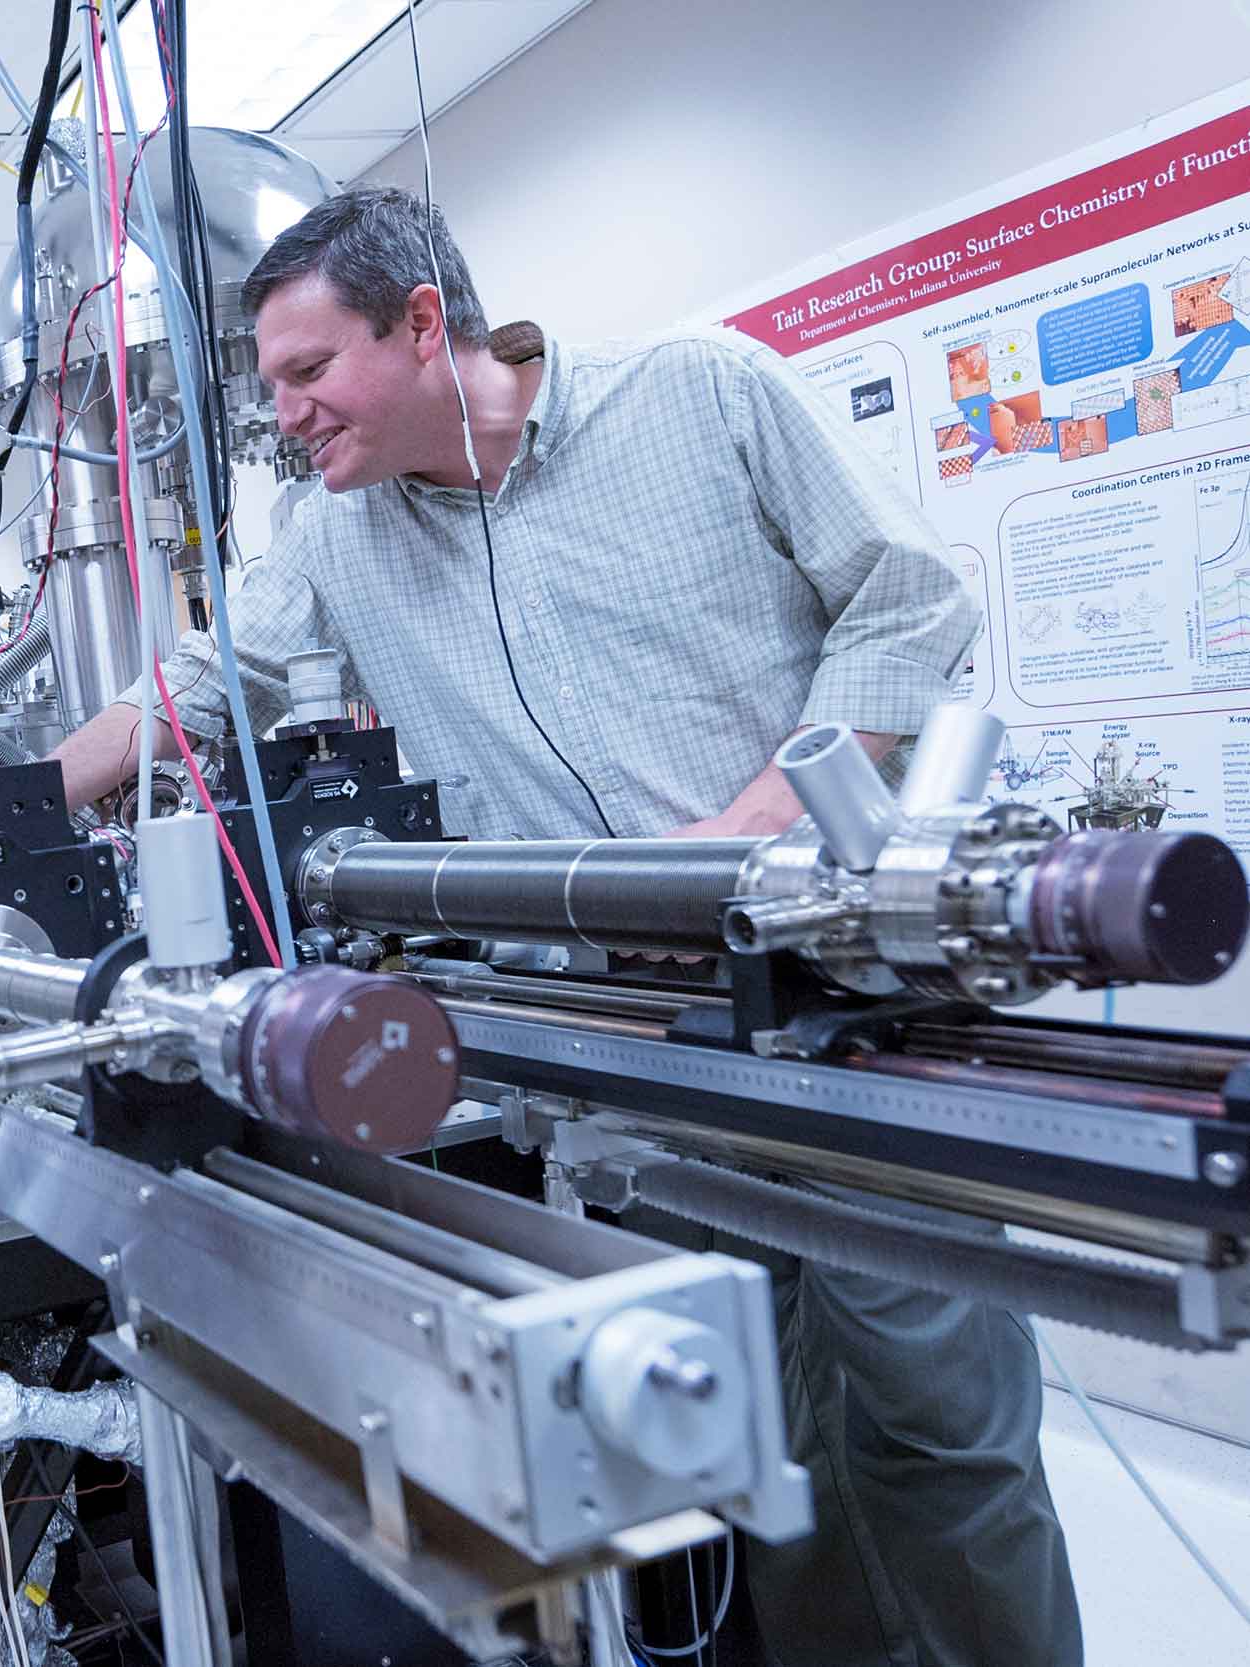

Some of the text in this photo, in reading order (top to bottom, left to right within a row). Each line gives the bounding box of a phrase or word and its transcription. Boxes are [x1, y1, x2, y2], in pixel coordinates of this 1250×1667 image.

[772, 306, 804, 333] Tait
[808, 272, 884, 319] Research
[888, 250, 962, 286] Group:
[965, 222, 1034, 258] Surface
[1039, 177, 1149, 230] Chemistry
[1154, 160, 1176, 188] of
[922, 304, 993, 339] Self-assembled,
[995, 279, 1079, 314] Nanometer-scale
[1081, 252, 1163, 286] Supramolecular
[1165, 232, 1221, 257] Networks
[1223, 225, 1235, 238] at
[799, 259, 1003, 341] Department of Chemistry, Indiana University
[832, 354, 863, 369] Surfaces
[1071, 453, 1250, 500] Coordination Centers in 2D Frame
[1200, 485, 1209, 494] Fe
[1210, 485, 1221, 494] 3p
[1230, 716, 1250, 725] X-ray
[1103, 723, 1128, 732] Energy
[1101, 731, 1131, 740] Analyzer
[1137, 742, 1157, 750] X-ray
[1046, 750, 1069, 759] Sample
[1135, 749, 1161, 758] Source
[1167, 811, 1209, 820] Deposition
